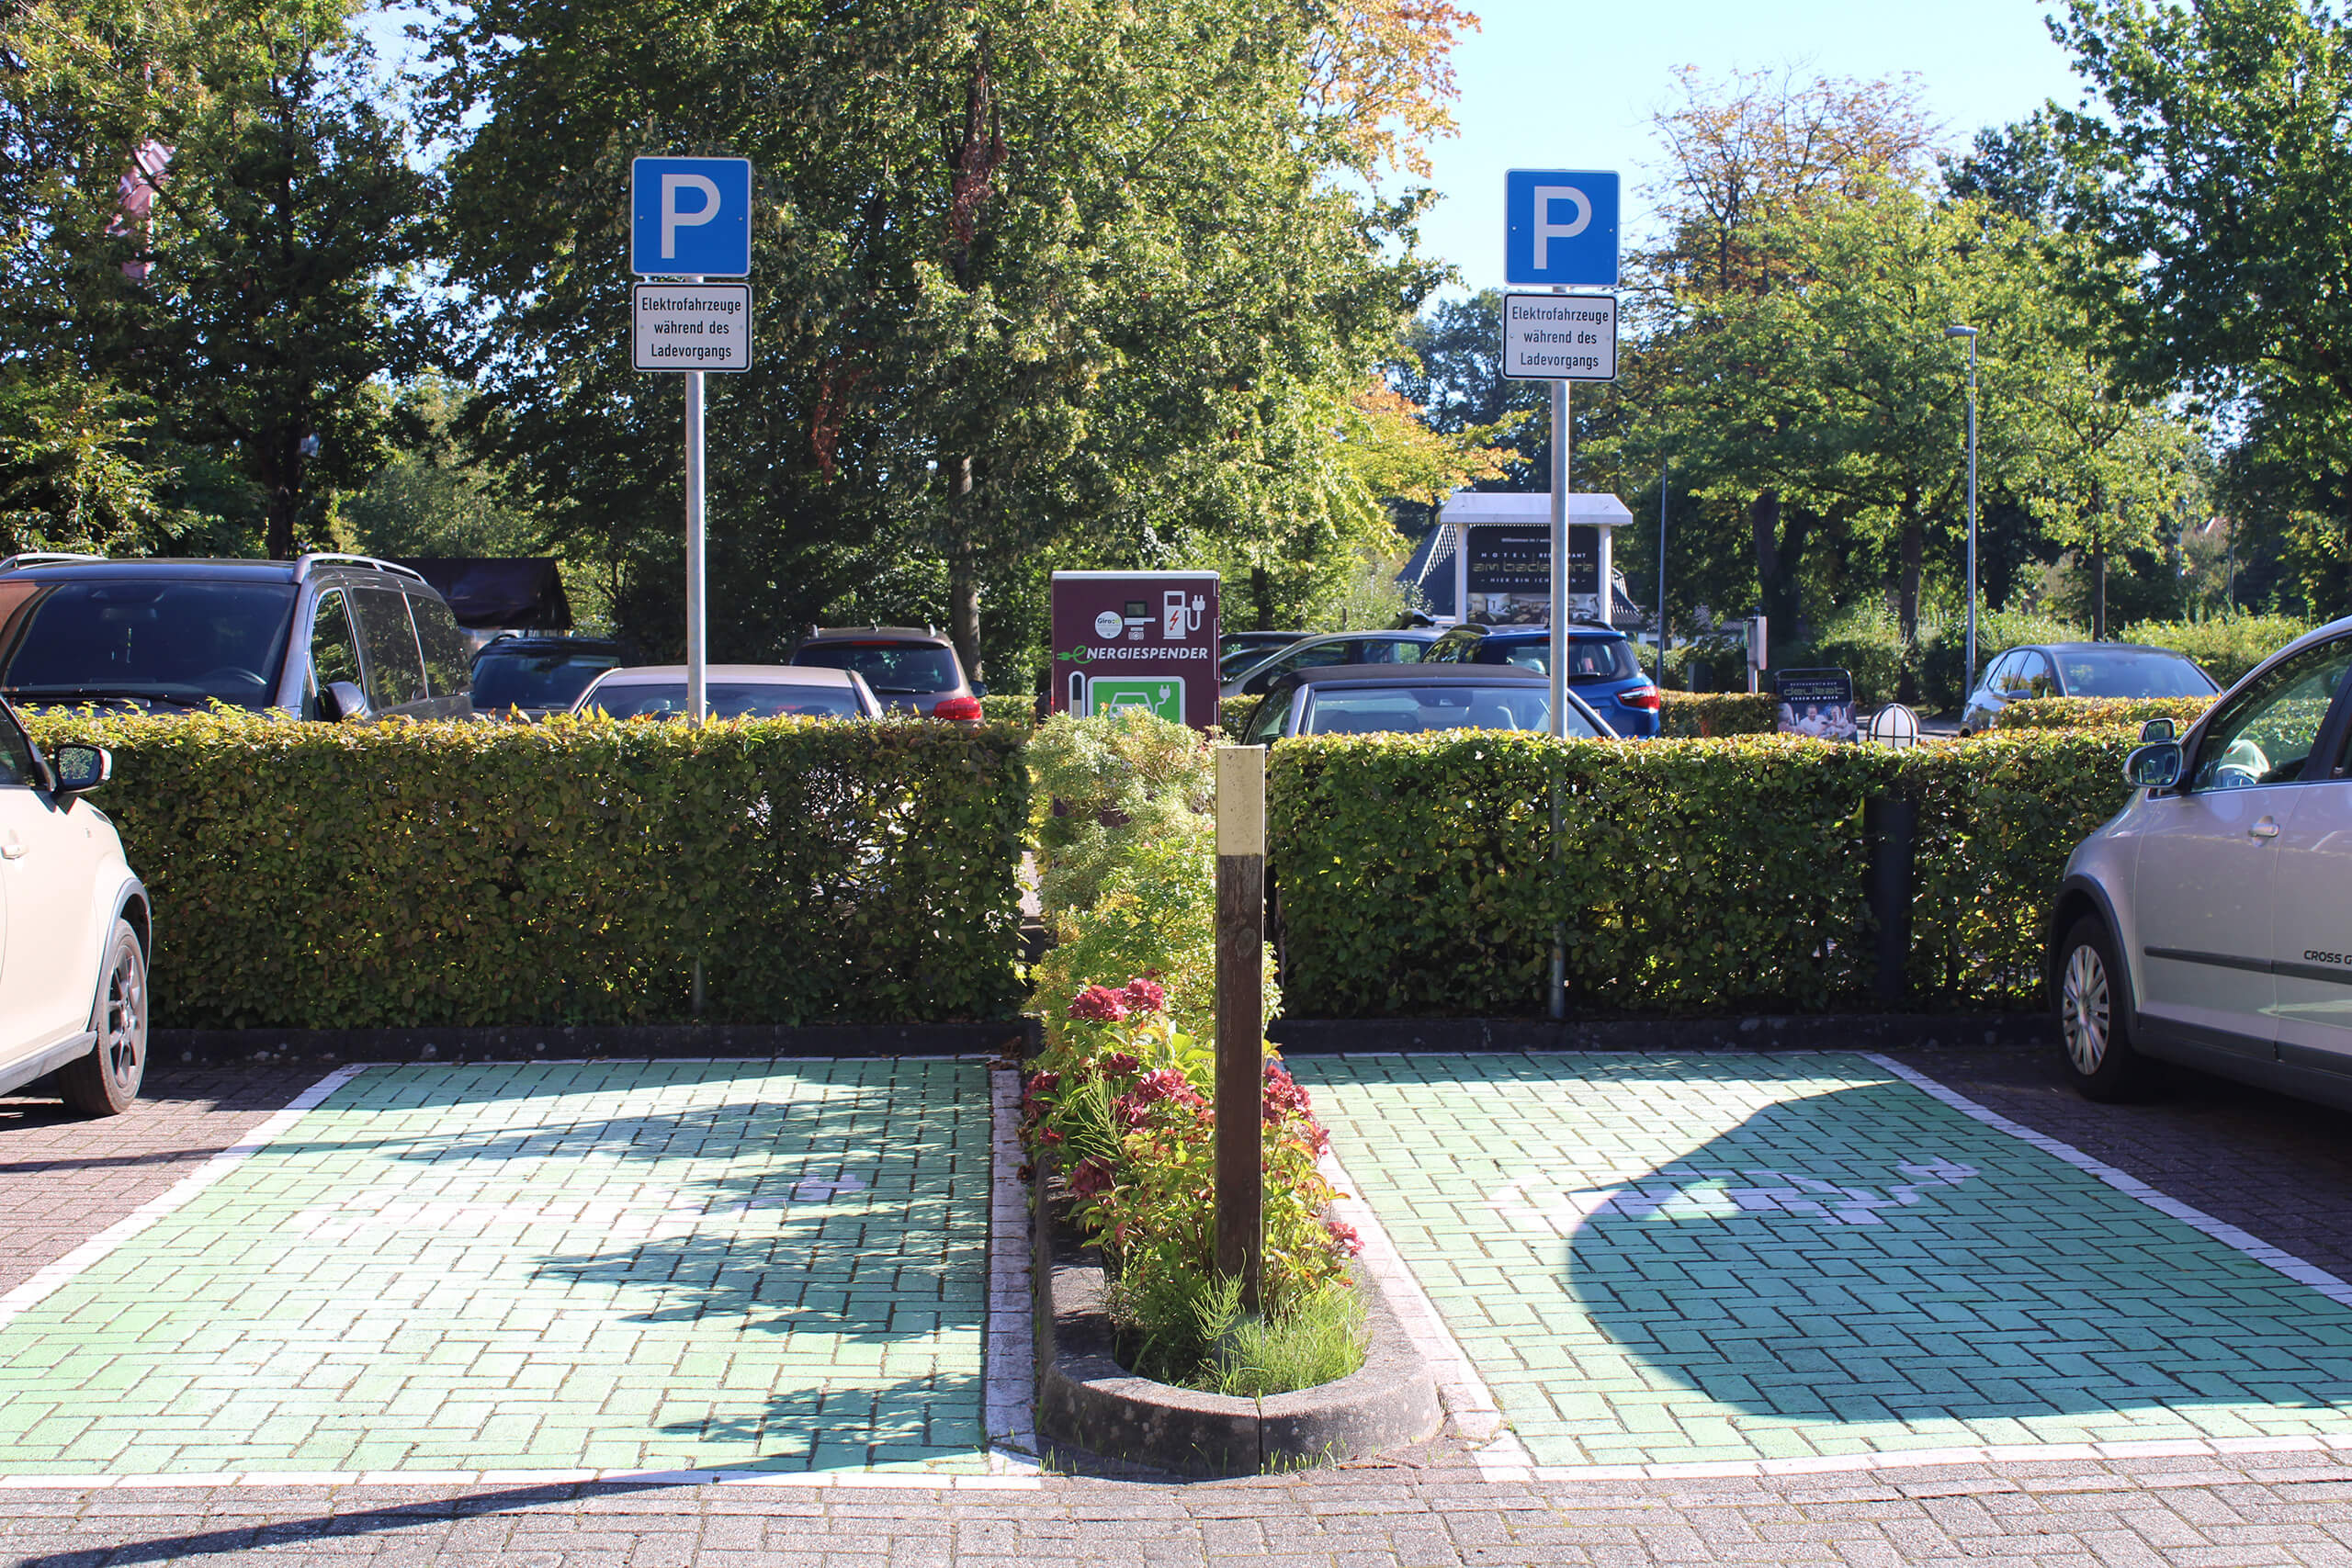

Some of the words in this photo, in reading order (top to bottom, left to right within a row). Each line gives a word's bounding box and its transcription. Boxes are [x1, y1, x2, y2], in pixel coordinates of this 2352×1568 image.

[662, 174, 721, 259] P
[1533, 186, 1592, 270] P
[642, 297, 741, 315] Elektrofahrzeuge
[1512, 306, 1609, 324] Elektrofahrzeuge
[654, 320, 704, 334] während
[709, 321, 729, 334] des
[1523, 329, 1572, 344] während
[1577, 331, 1597, 344] des
[650, 344, 732, 360] Ladevorgangs
[1521, 352, 1599, 369] Ladevorgangs
[2303, 950, 2342, 964] CROSS
